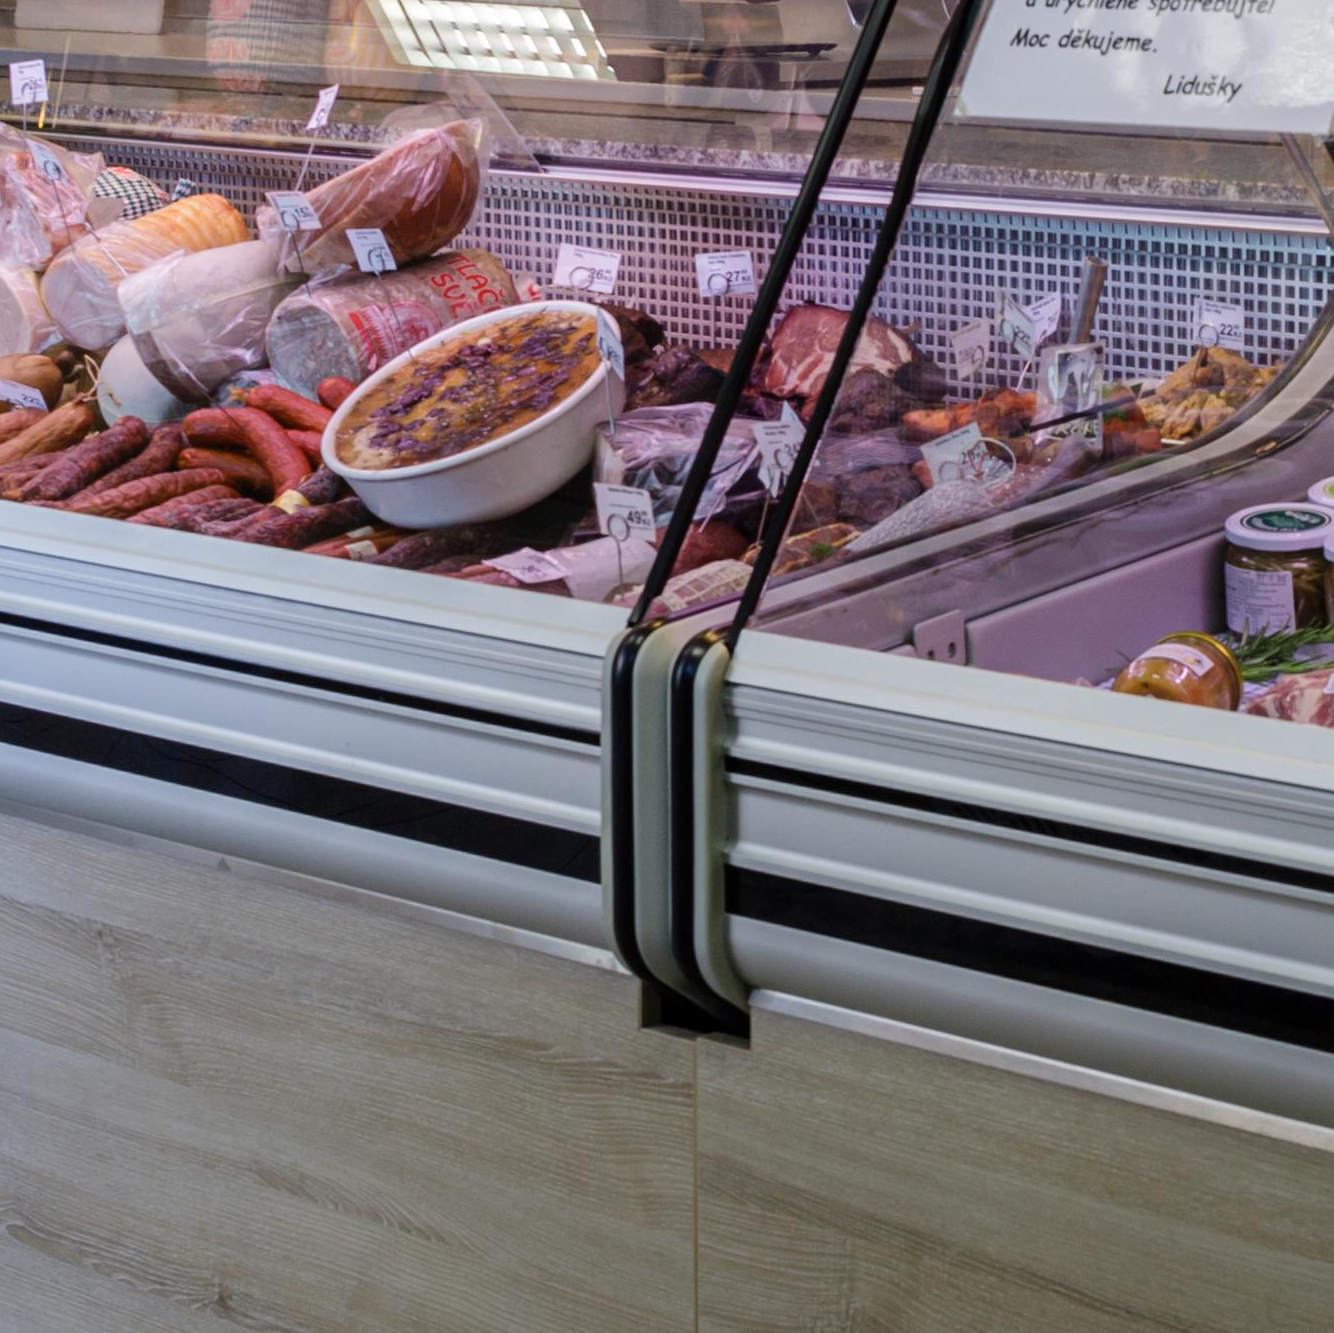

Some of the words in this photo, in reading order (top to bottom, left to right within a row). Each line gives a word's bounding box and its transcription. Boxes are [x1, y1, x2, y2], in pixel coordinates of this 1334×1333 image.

[1009, 29, 1050, 49] Moc
[1057, 26, 1159, 55] děkujeme.
[1162, 72, 1243, 101] Lidušky
[1218, 323, 1234, 336] 22
[626, 509, 642, 525] 49
